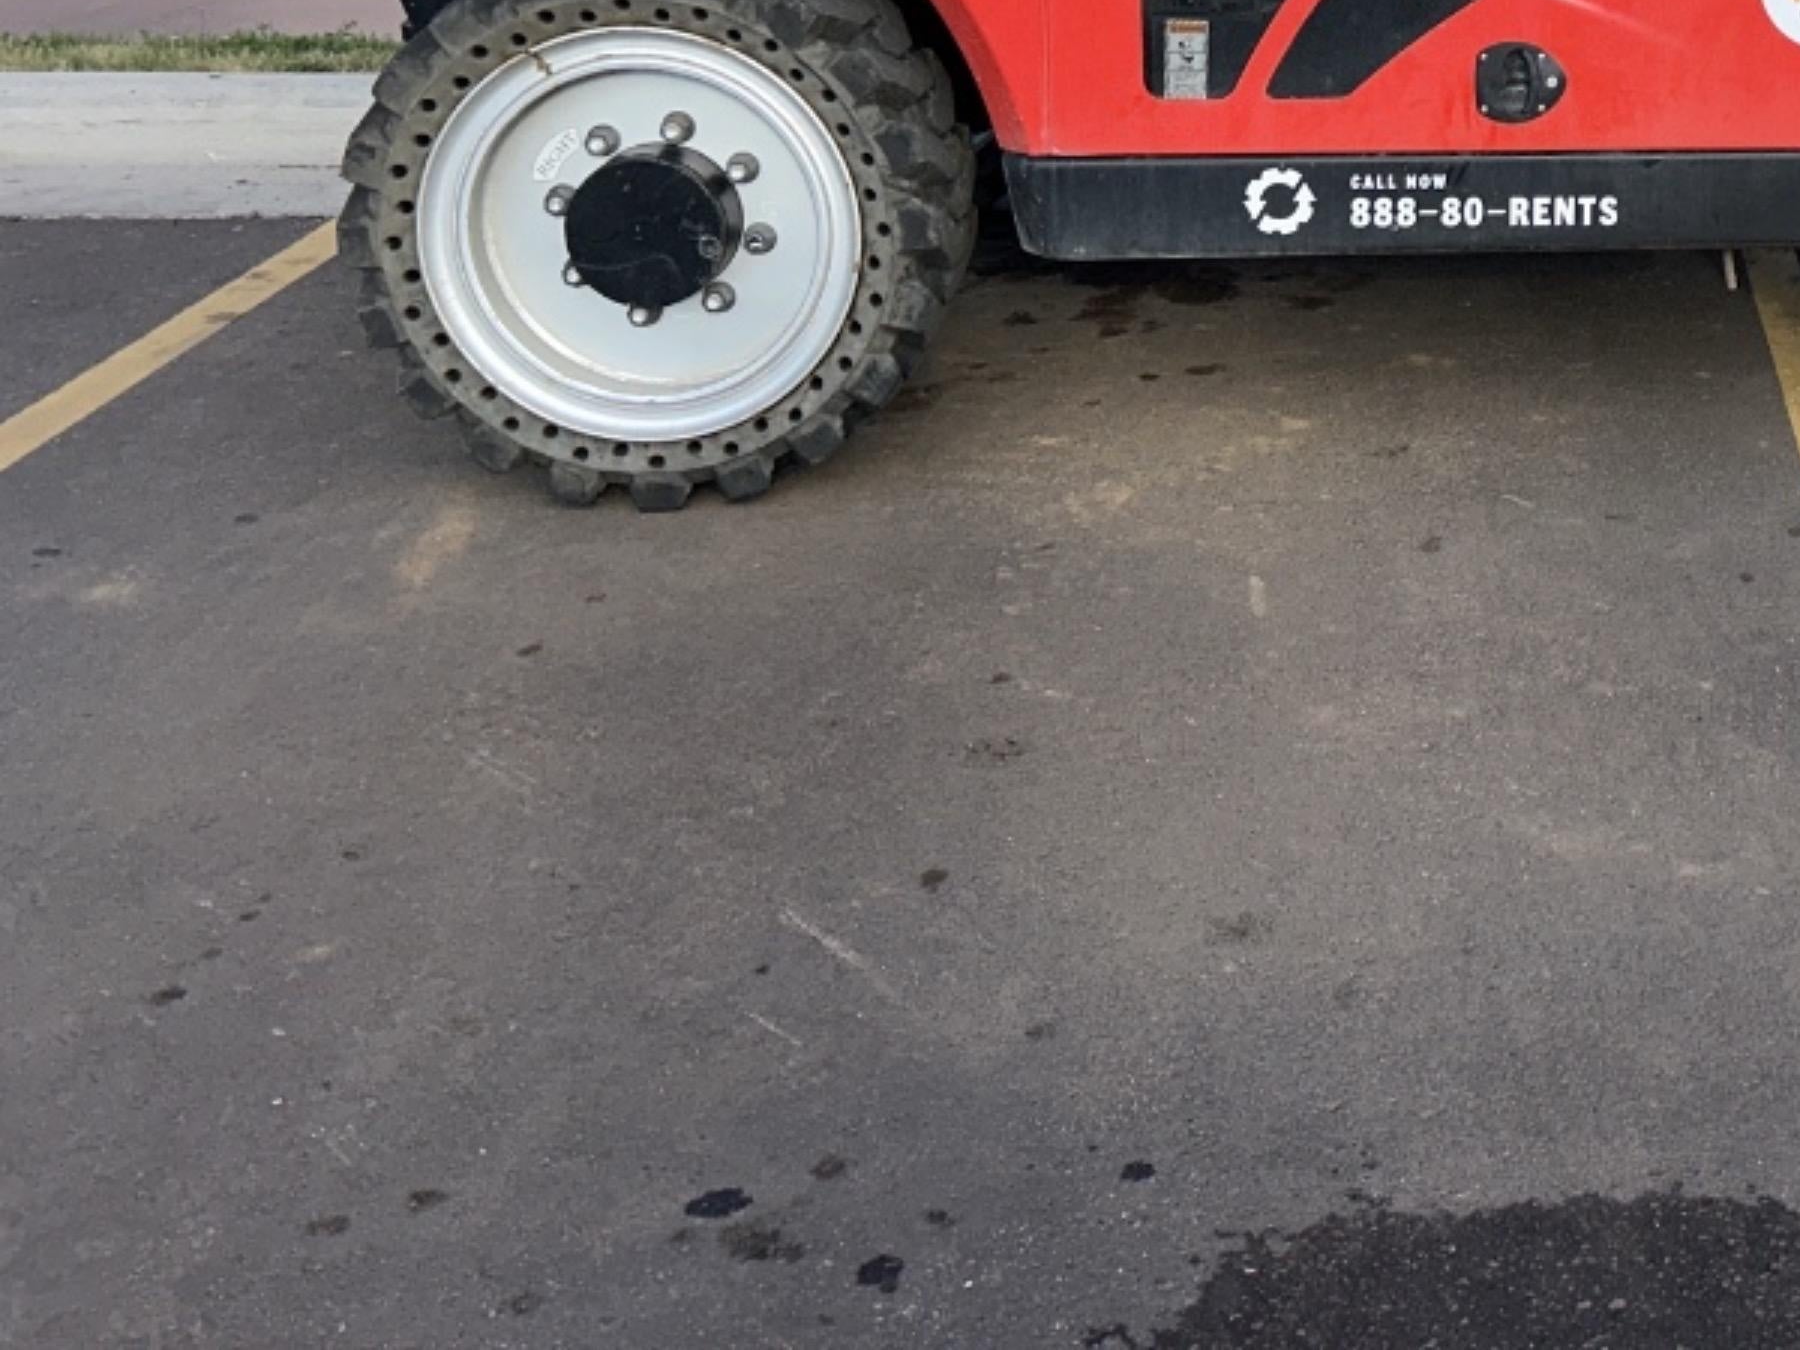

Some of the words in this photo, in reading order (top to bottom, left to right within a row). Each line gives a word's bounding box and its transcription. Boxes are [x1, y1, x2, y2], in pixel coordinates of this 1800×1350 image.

[1350, 173, 1397, 190] CALL
[1405, 173, 1448, 190] NOW
[1350, 196, 1618, 228] 888-80-RENTS
